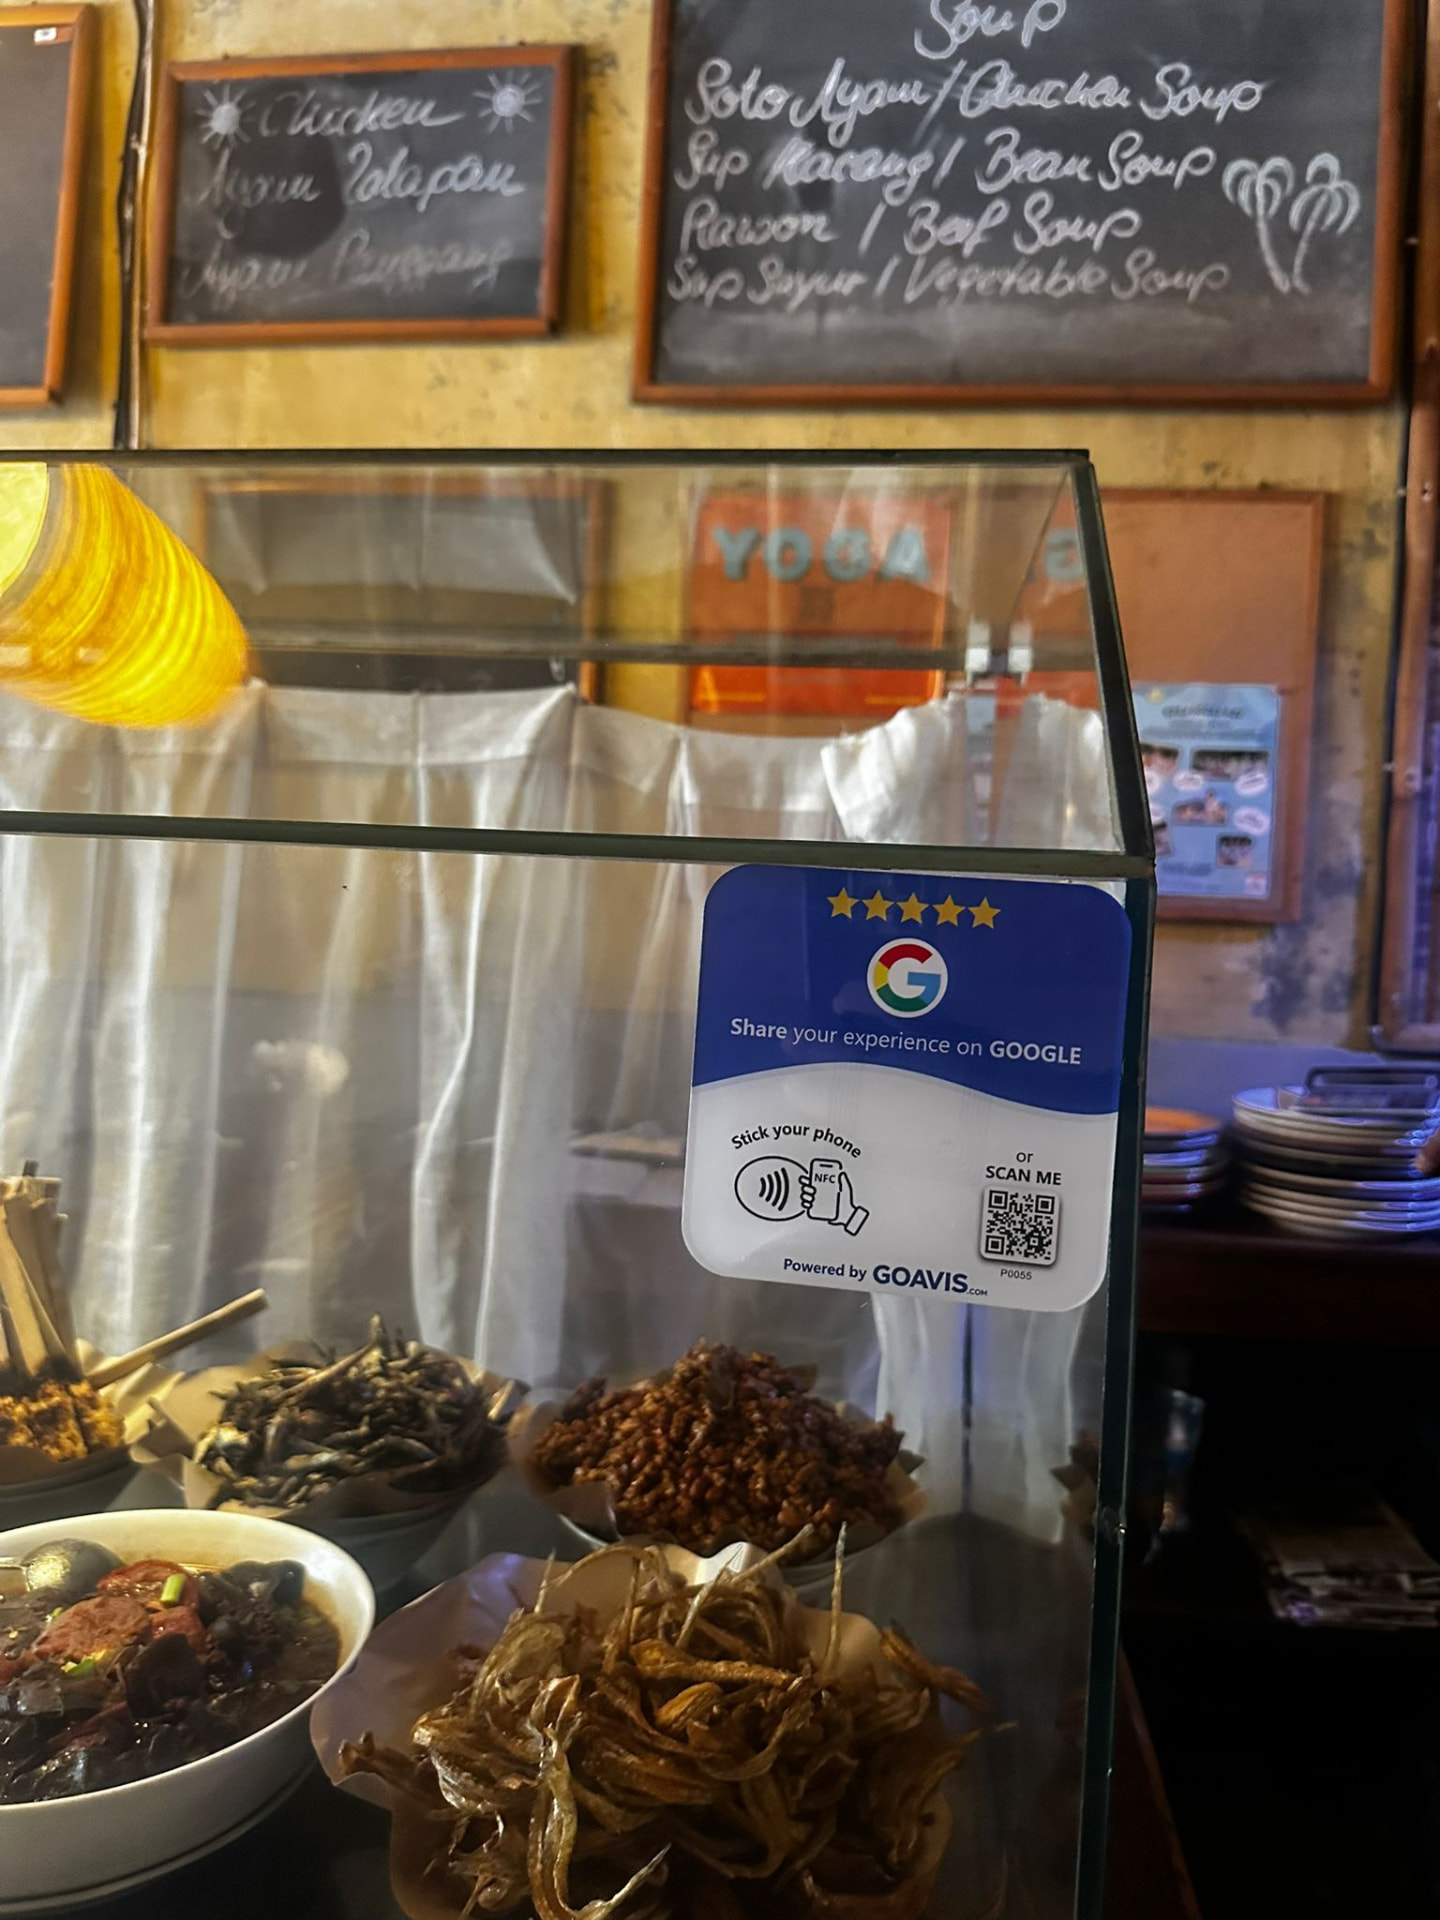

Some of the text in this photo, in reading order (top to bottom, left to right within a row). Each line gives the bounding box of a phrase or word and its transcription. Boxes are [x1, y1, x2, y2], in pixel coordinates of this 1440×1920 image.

[914, 0, 1066, 59] Soup
[258, 88, 466, 137] Chicken
[684, 57, 791, 125] Soto
[789, 56, 932, 148] Ayam
[1140, 62, 1263, 123] Soup
[674, 128, 749, 191] Sup
[975, 126, 1094, 194] Bean
[1098, 129, 1217, 190] Soup
[680, 196, 838, 256] Rawon
[1013, 190, 1142, 252] Soup
[667, 252, 745, 308] Sup
[1110, 248, 1229, 304] Soup
[712, 525, 931, 582] YOGA
[730, 1018, 1082, 1065] Share your experience on GOOGLE
[731, 1124, 862, 1159] Stick your phone
[1015, 1151, 1034, 1163] or
[814, 1173, 837, 1184] NFC
[985, 1165, 1062, 1186] SCAN ME
[783, 1258, 845, 1277] Powered
[849, 1264, 867, 1281] by
[1000, 1268, 1032, 1280] P0055
